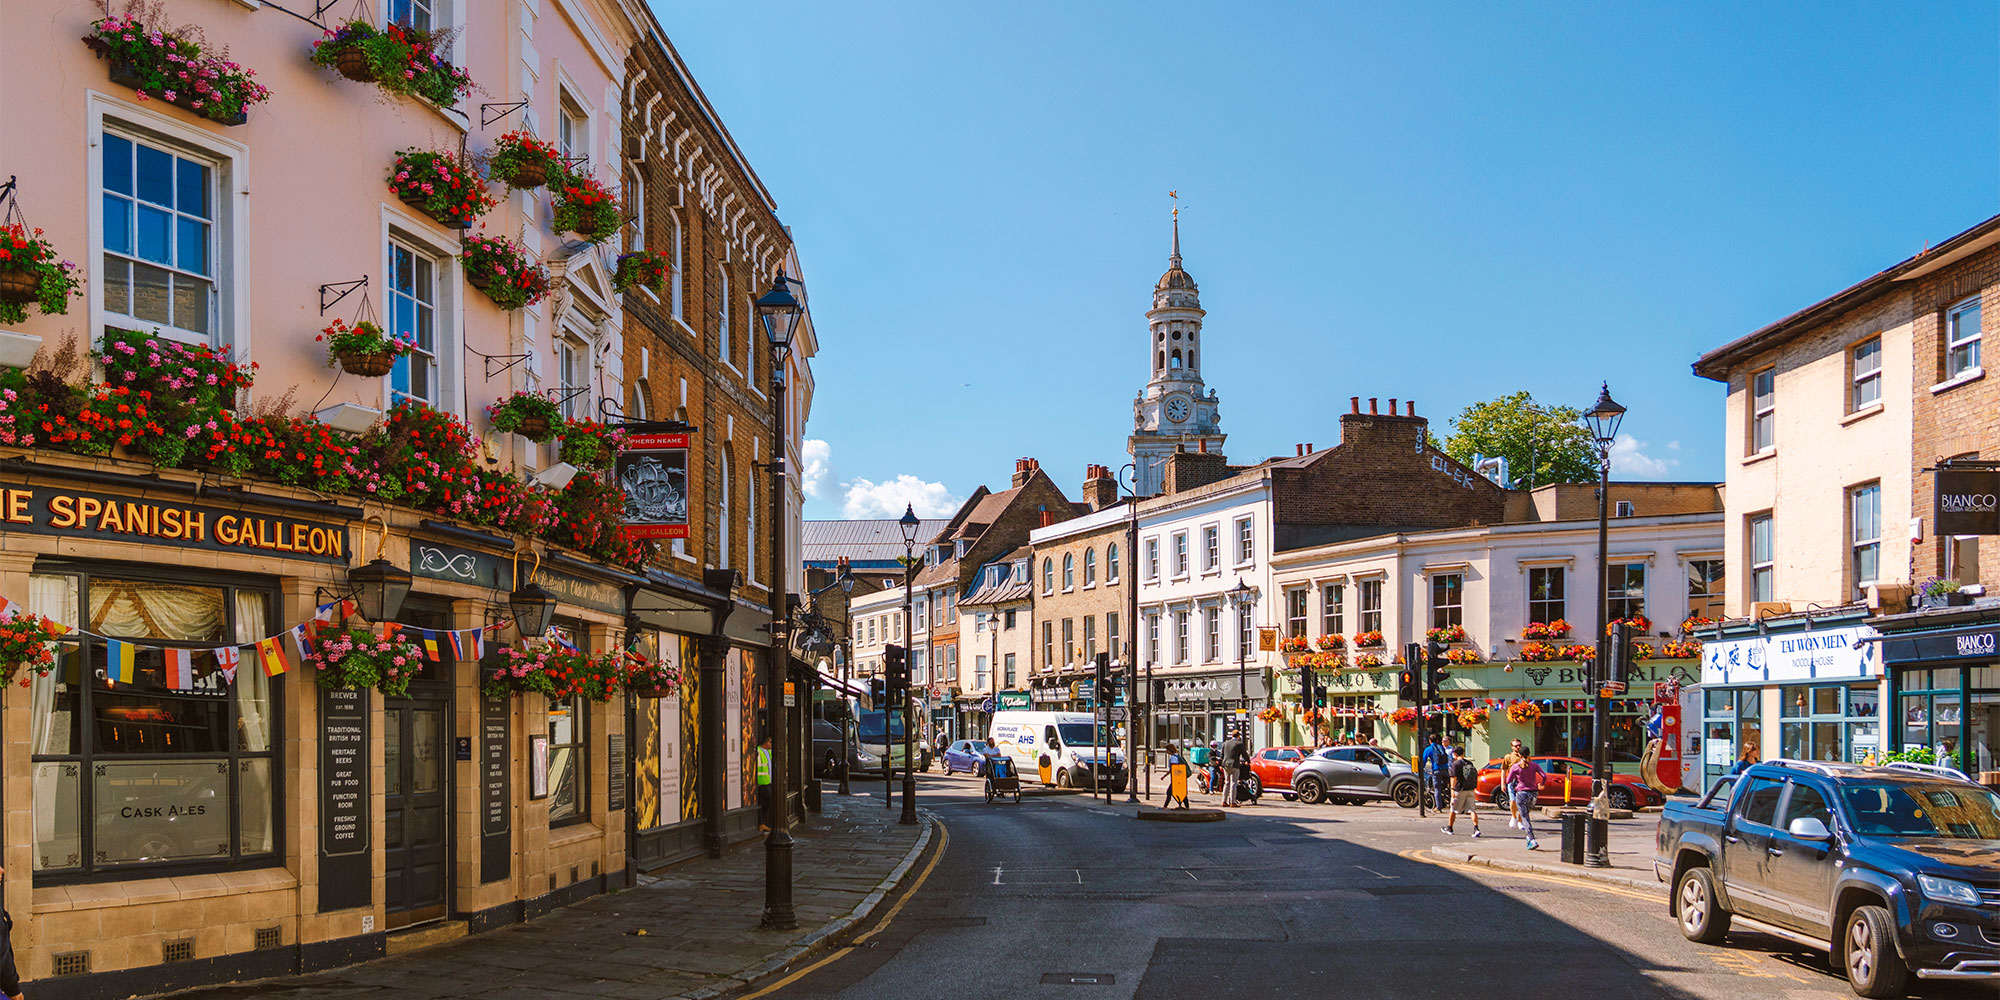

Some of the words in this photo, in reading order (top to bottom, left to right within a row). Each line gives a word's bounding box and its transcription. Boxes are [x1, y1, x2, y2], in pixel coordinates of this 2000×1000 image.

[1941, 493, 1997, 507] BIANCO
[49, 494, 206, 542] SPANISH
[214, 514, 343, 558] GALLEON
[650, 528, 684, 536] GALLEON
[1781, 639, 1795, 653] TAI
[1798, 637, 1821, 651] WON
[1822, 634, 1848, 649] MEIN
[1957, 633, 1994, 650] BIANCO
[1815, 656, 1834, 666] HOUSE
[330, 691, 358, 700] BREWER
[1018, 735, 1035, 745] AHS
[332, 793, 358, 801] FUNCTION
[121, 805, 163, 819] CASK
[168, 804, 206, 817] ALES
[333, 815, 357, 823] FRESHLY
[334, 823, 356, 832] GROUND
[335, 832, 355, 840] COFFEE
